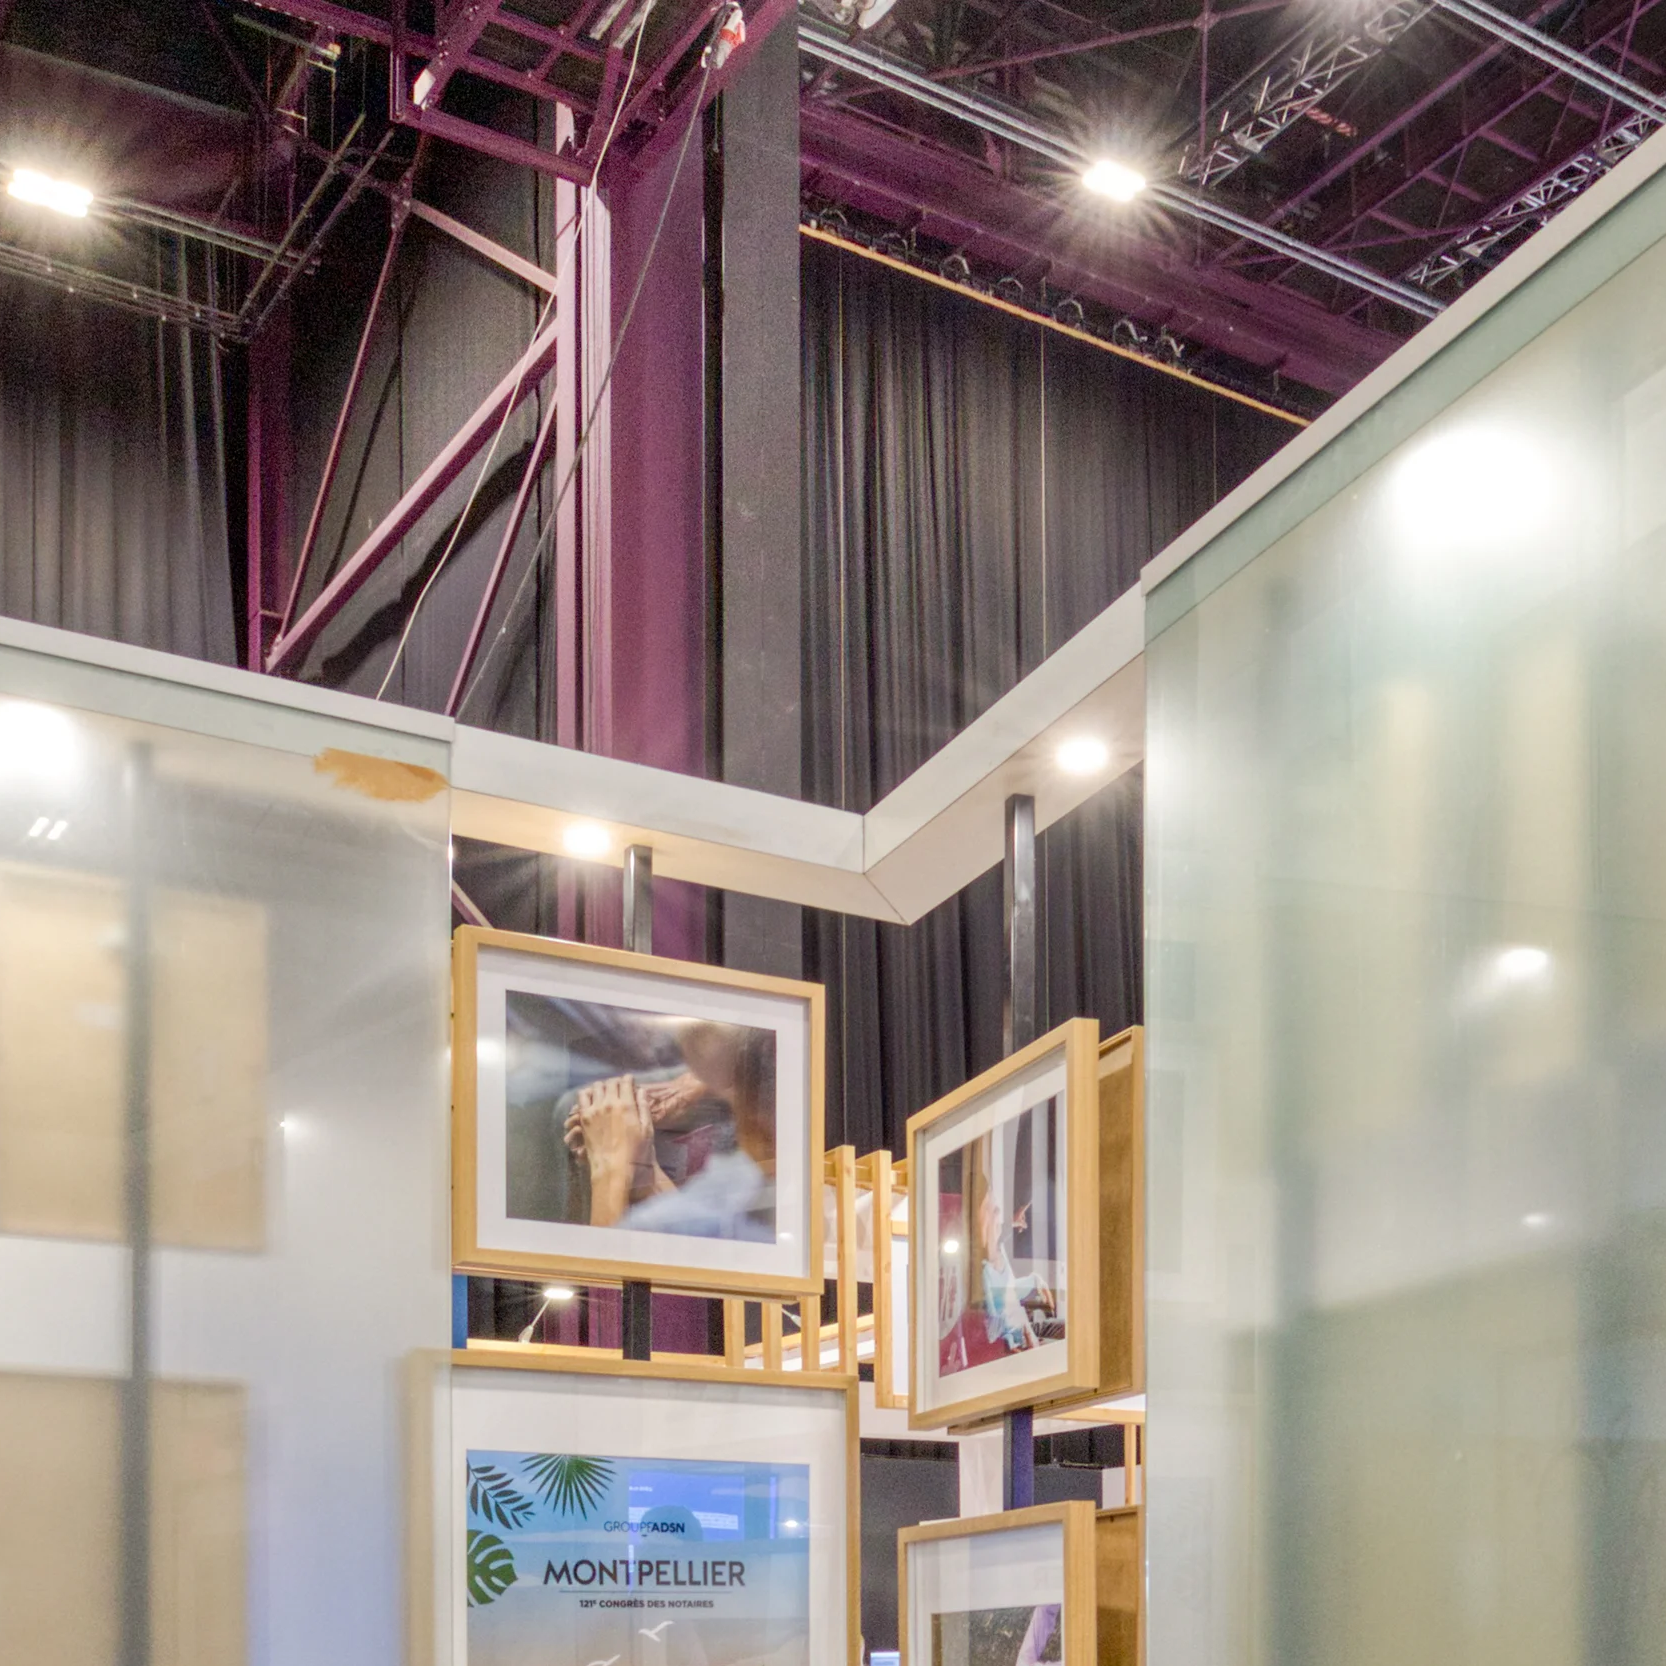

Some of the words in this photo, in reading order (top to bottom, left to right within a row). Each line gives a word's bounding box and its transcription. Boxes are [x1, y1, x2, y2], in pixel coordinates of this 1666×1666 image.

[543, 1559, 746, 1587] MONTPELLIER
[599, 1597, 645, 1608] CONGRÈS
[647, 1600, 665, 1608] DES
[668, 1600, 714, 1608] NOTAIRES
